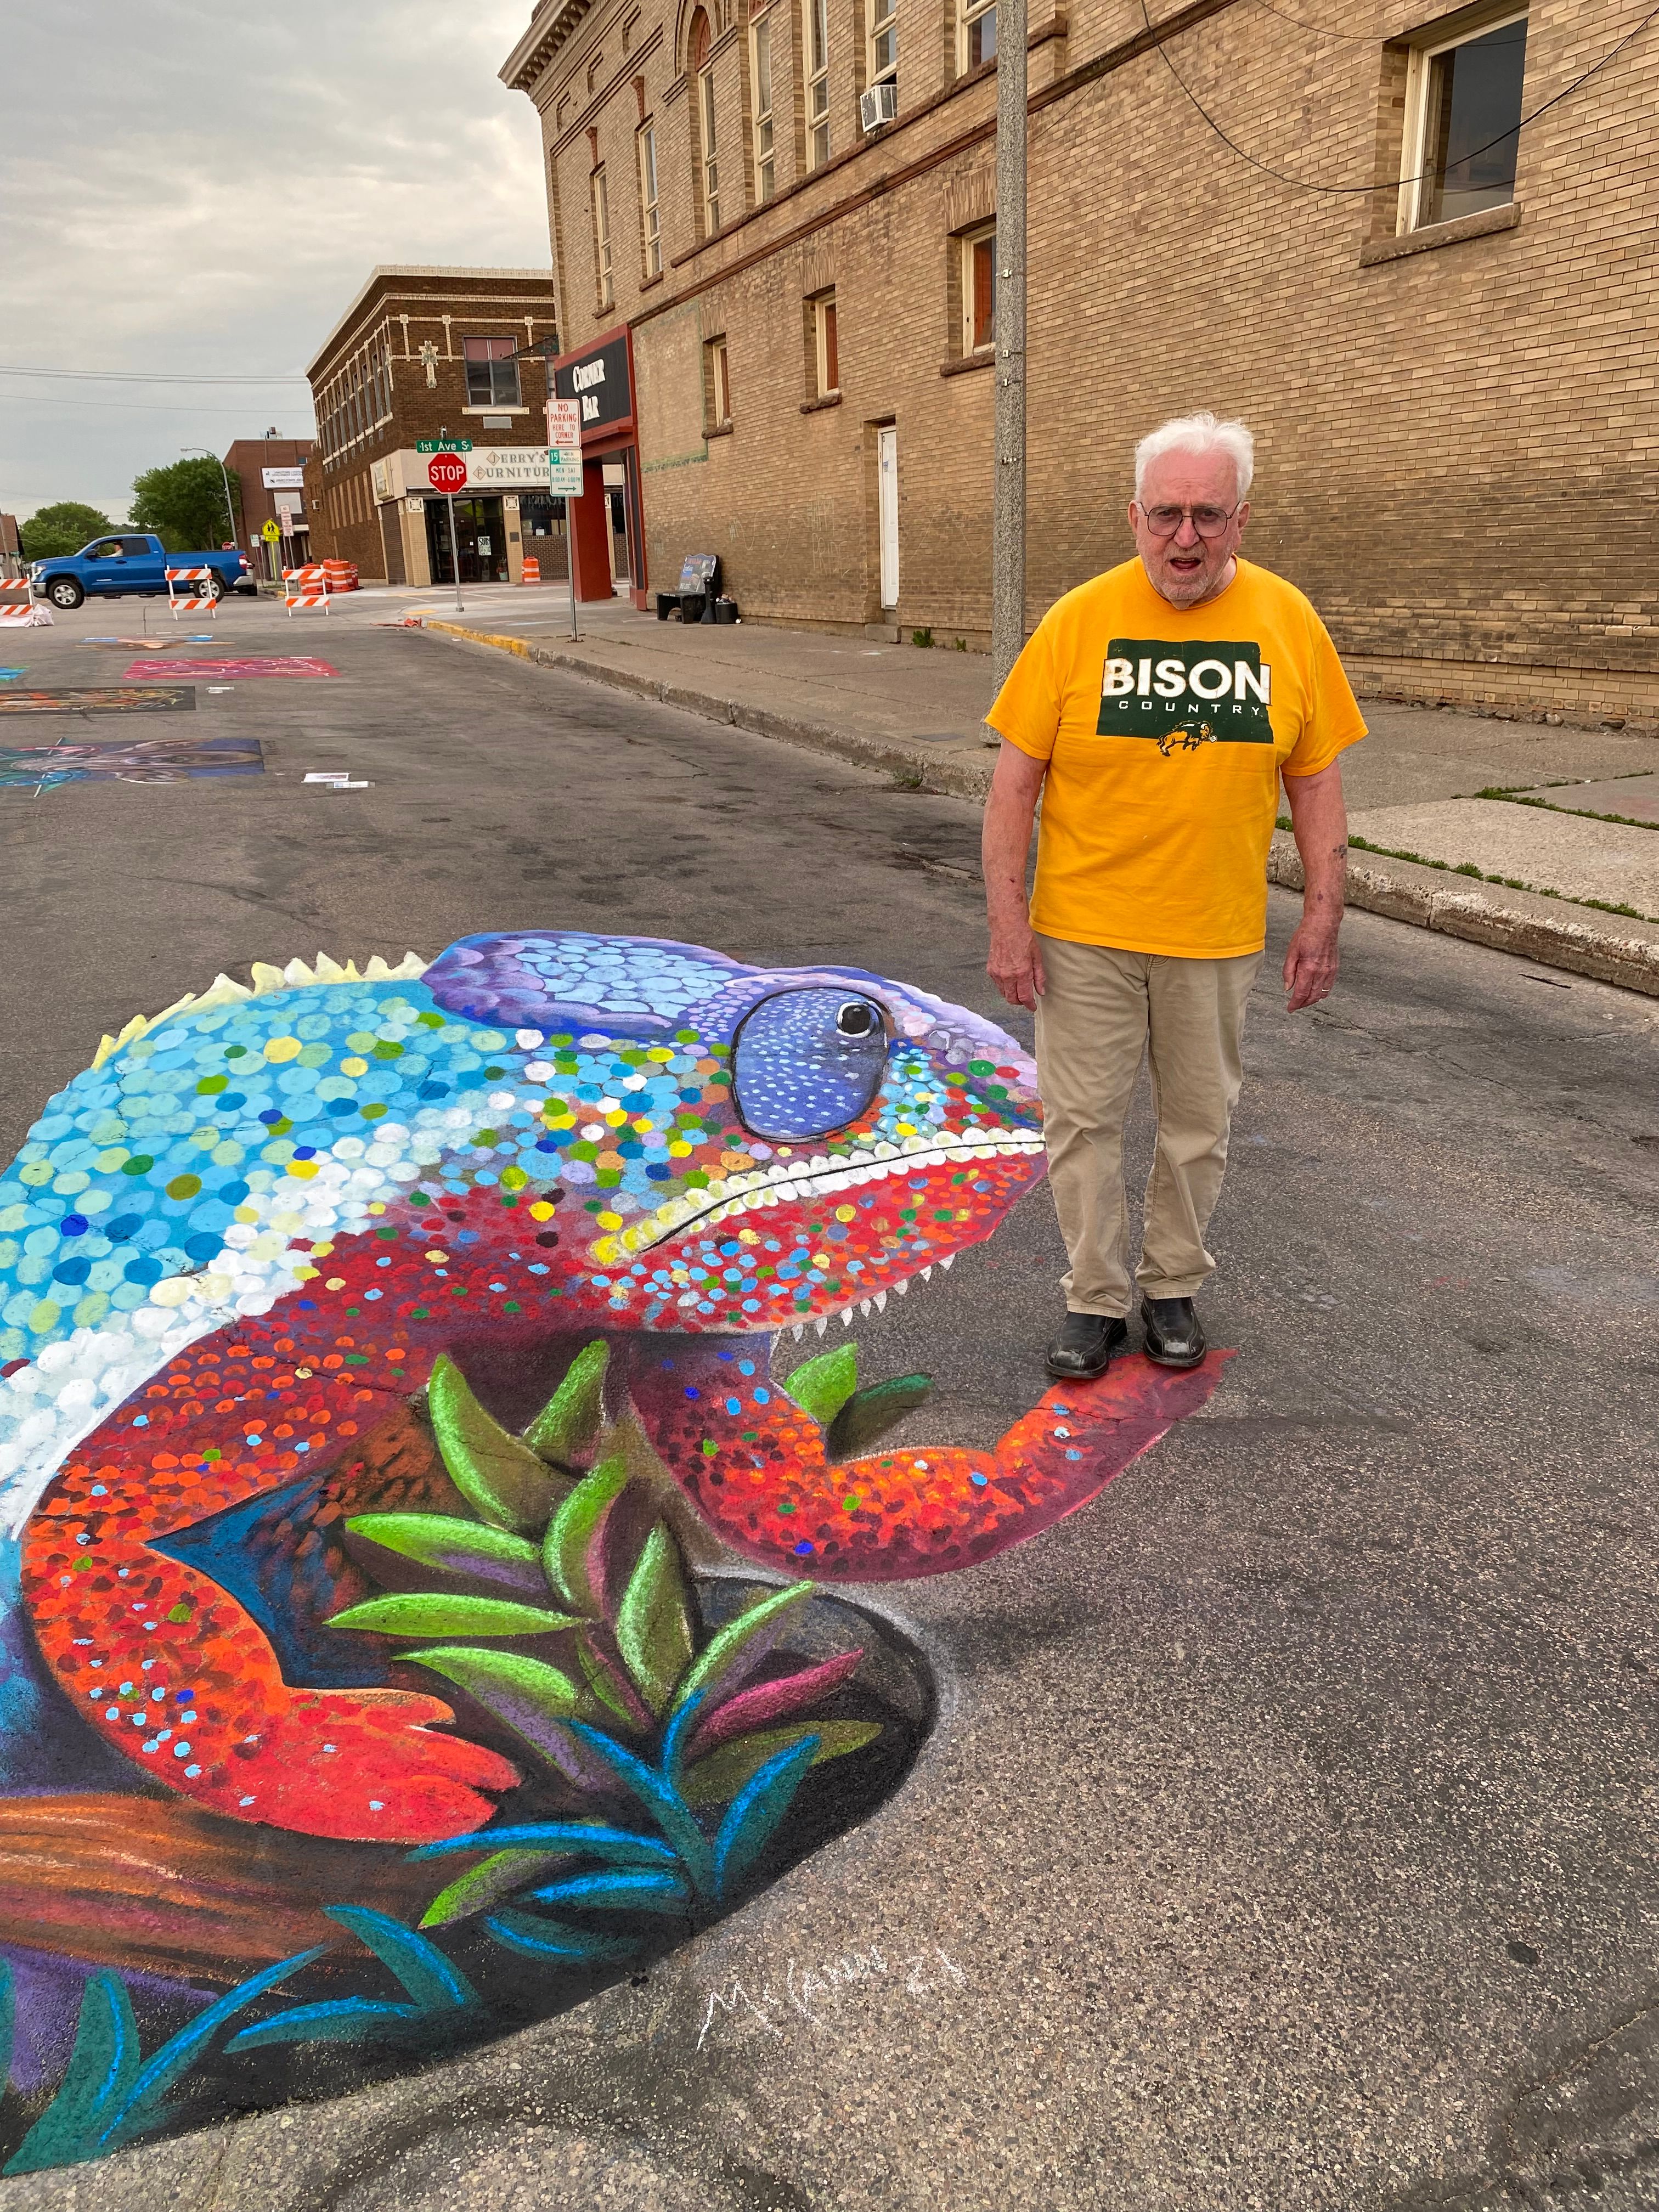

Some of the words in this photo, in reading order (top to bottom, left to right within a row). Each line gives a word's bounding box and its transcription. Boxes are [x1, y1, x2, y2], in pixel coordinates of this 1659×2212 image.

[573, 359, 606, 393] CORNER
[558, 403, 568, 412] NO
[582, 395, 600, 422] BAR
[550, 413, 577, 422] PARKING
[420, 442, 432, 451] 1st
[438, 441, 456, 451] Ave
[461, 441, 467, 450] S
[491, 452, 545, 464] JERRY'S
[550, 452, 558, 461] 15
[431, 465, 464, 481] STOP
[477, 467, 549, 478] FURNITUR
[1102, 658, 1271, 706] BISON
[1118, 700, 1260, 715] COUNTRY
